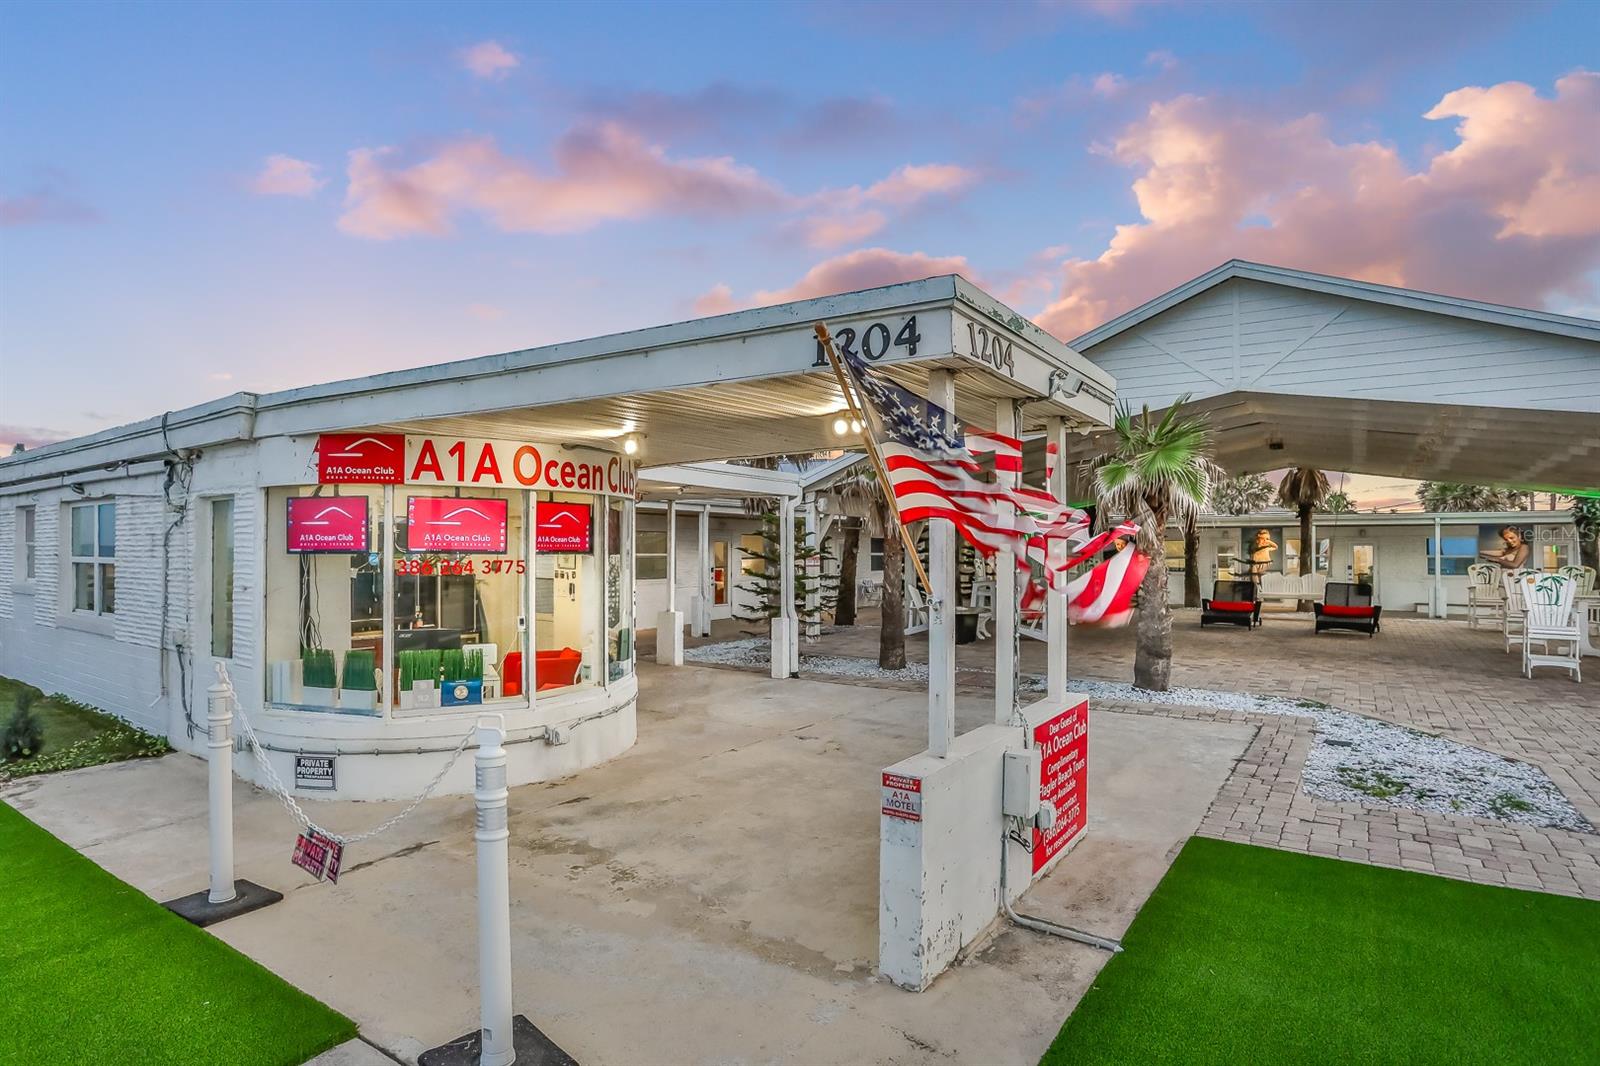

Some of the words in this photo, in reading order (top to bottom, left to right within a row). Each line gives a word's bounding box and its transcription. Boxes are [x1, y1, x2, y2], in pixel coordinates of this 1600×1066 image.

[811, 315, 921, 367] 1204
[967, 322, 1015, 378] 1204
[373, 467, 395, 475] Club
[411, 439, 503, 484] A1A
[513, 445, 604, 491] Ocean
[608, 456, 635, 495] Club
[471, 534, 491, 542] Club
[395, 560, 434, 576] 386
[440, 560, 474, 575] 264
[481, 560, 526, 575] 3775
[1049, 722, 1061, 736] Dear
[1060, 715, 1073, 729] Guest
[1053, 732, 1074, 753] Ocean
[1073, 719, 1087, 739] Club
[300, 758, 329, 768] PRIVATE
[1047, 749, 1079, 776] Complimentary
[296, 766, 333, 776] PROPERTY
[1058, 764, 1073, 784] Beach
[1073, 758, 1085, 773] Tours
[886, 780, 917, 791] PROPERTY
[890, 776, 913, 785] PRIVATE
[892, 790, 911, 801] A1A
[886, 798, 916, 812] MOTEL
